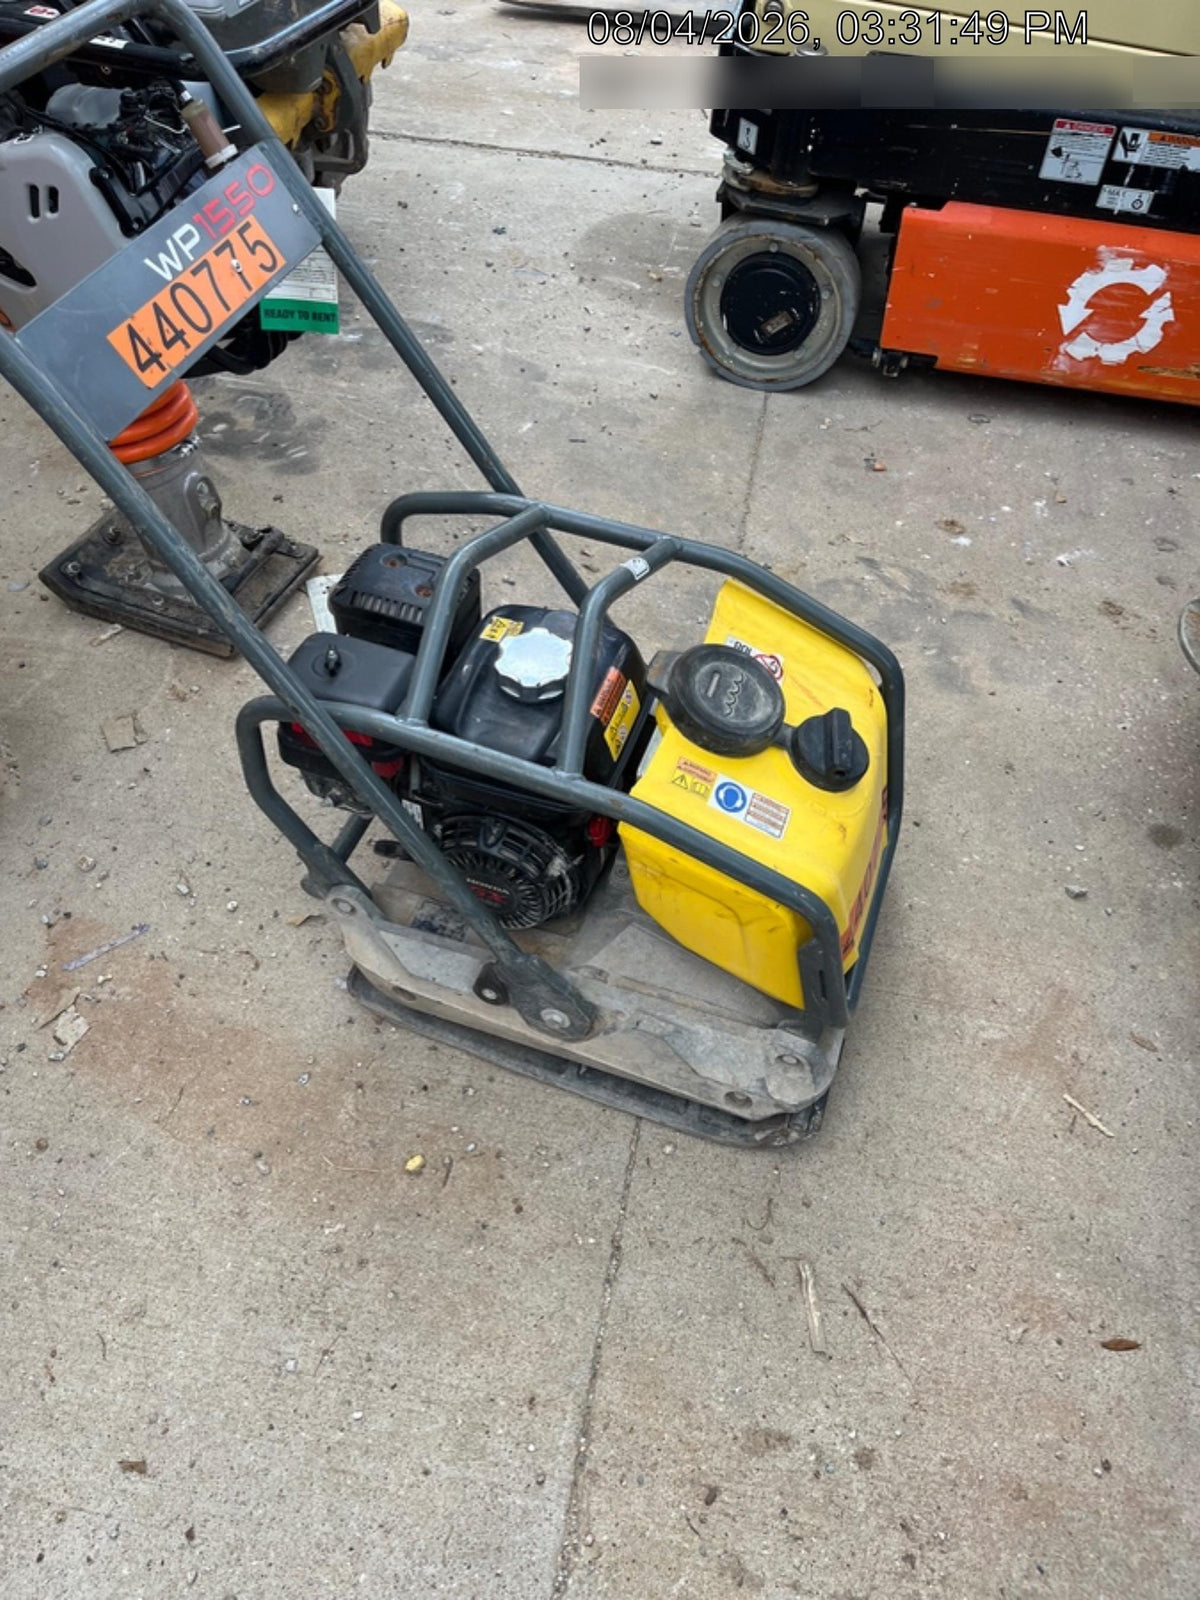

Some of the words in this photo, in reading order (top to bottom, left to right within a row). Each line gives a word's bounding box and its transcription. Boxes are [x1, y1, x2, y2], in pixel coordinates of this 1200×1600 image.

[143, 163, 275, 281] WP1550
[126, 221, 278, 373] 440775
[264, 308, 295, 319] READY
[298, 310, 310, 320] TO
[312, 311, 336, 322] RENT
